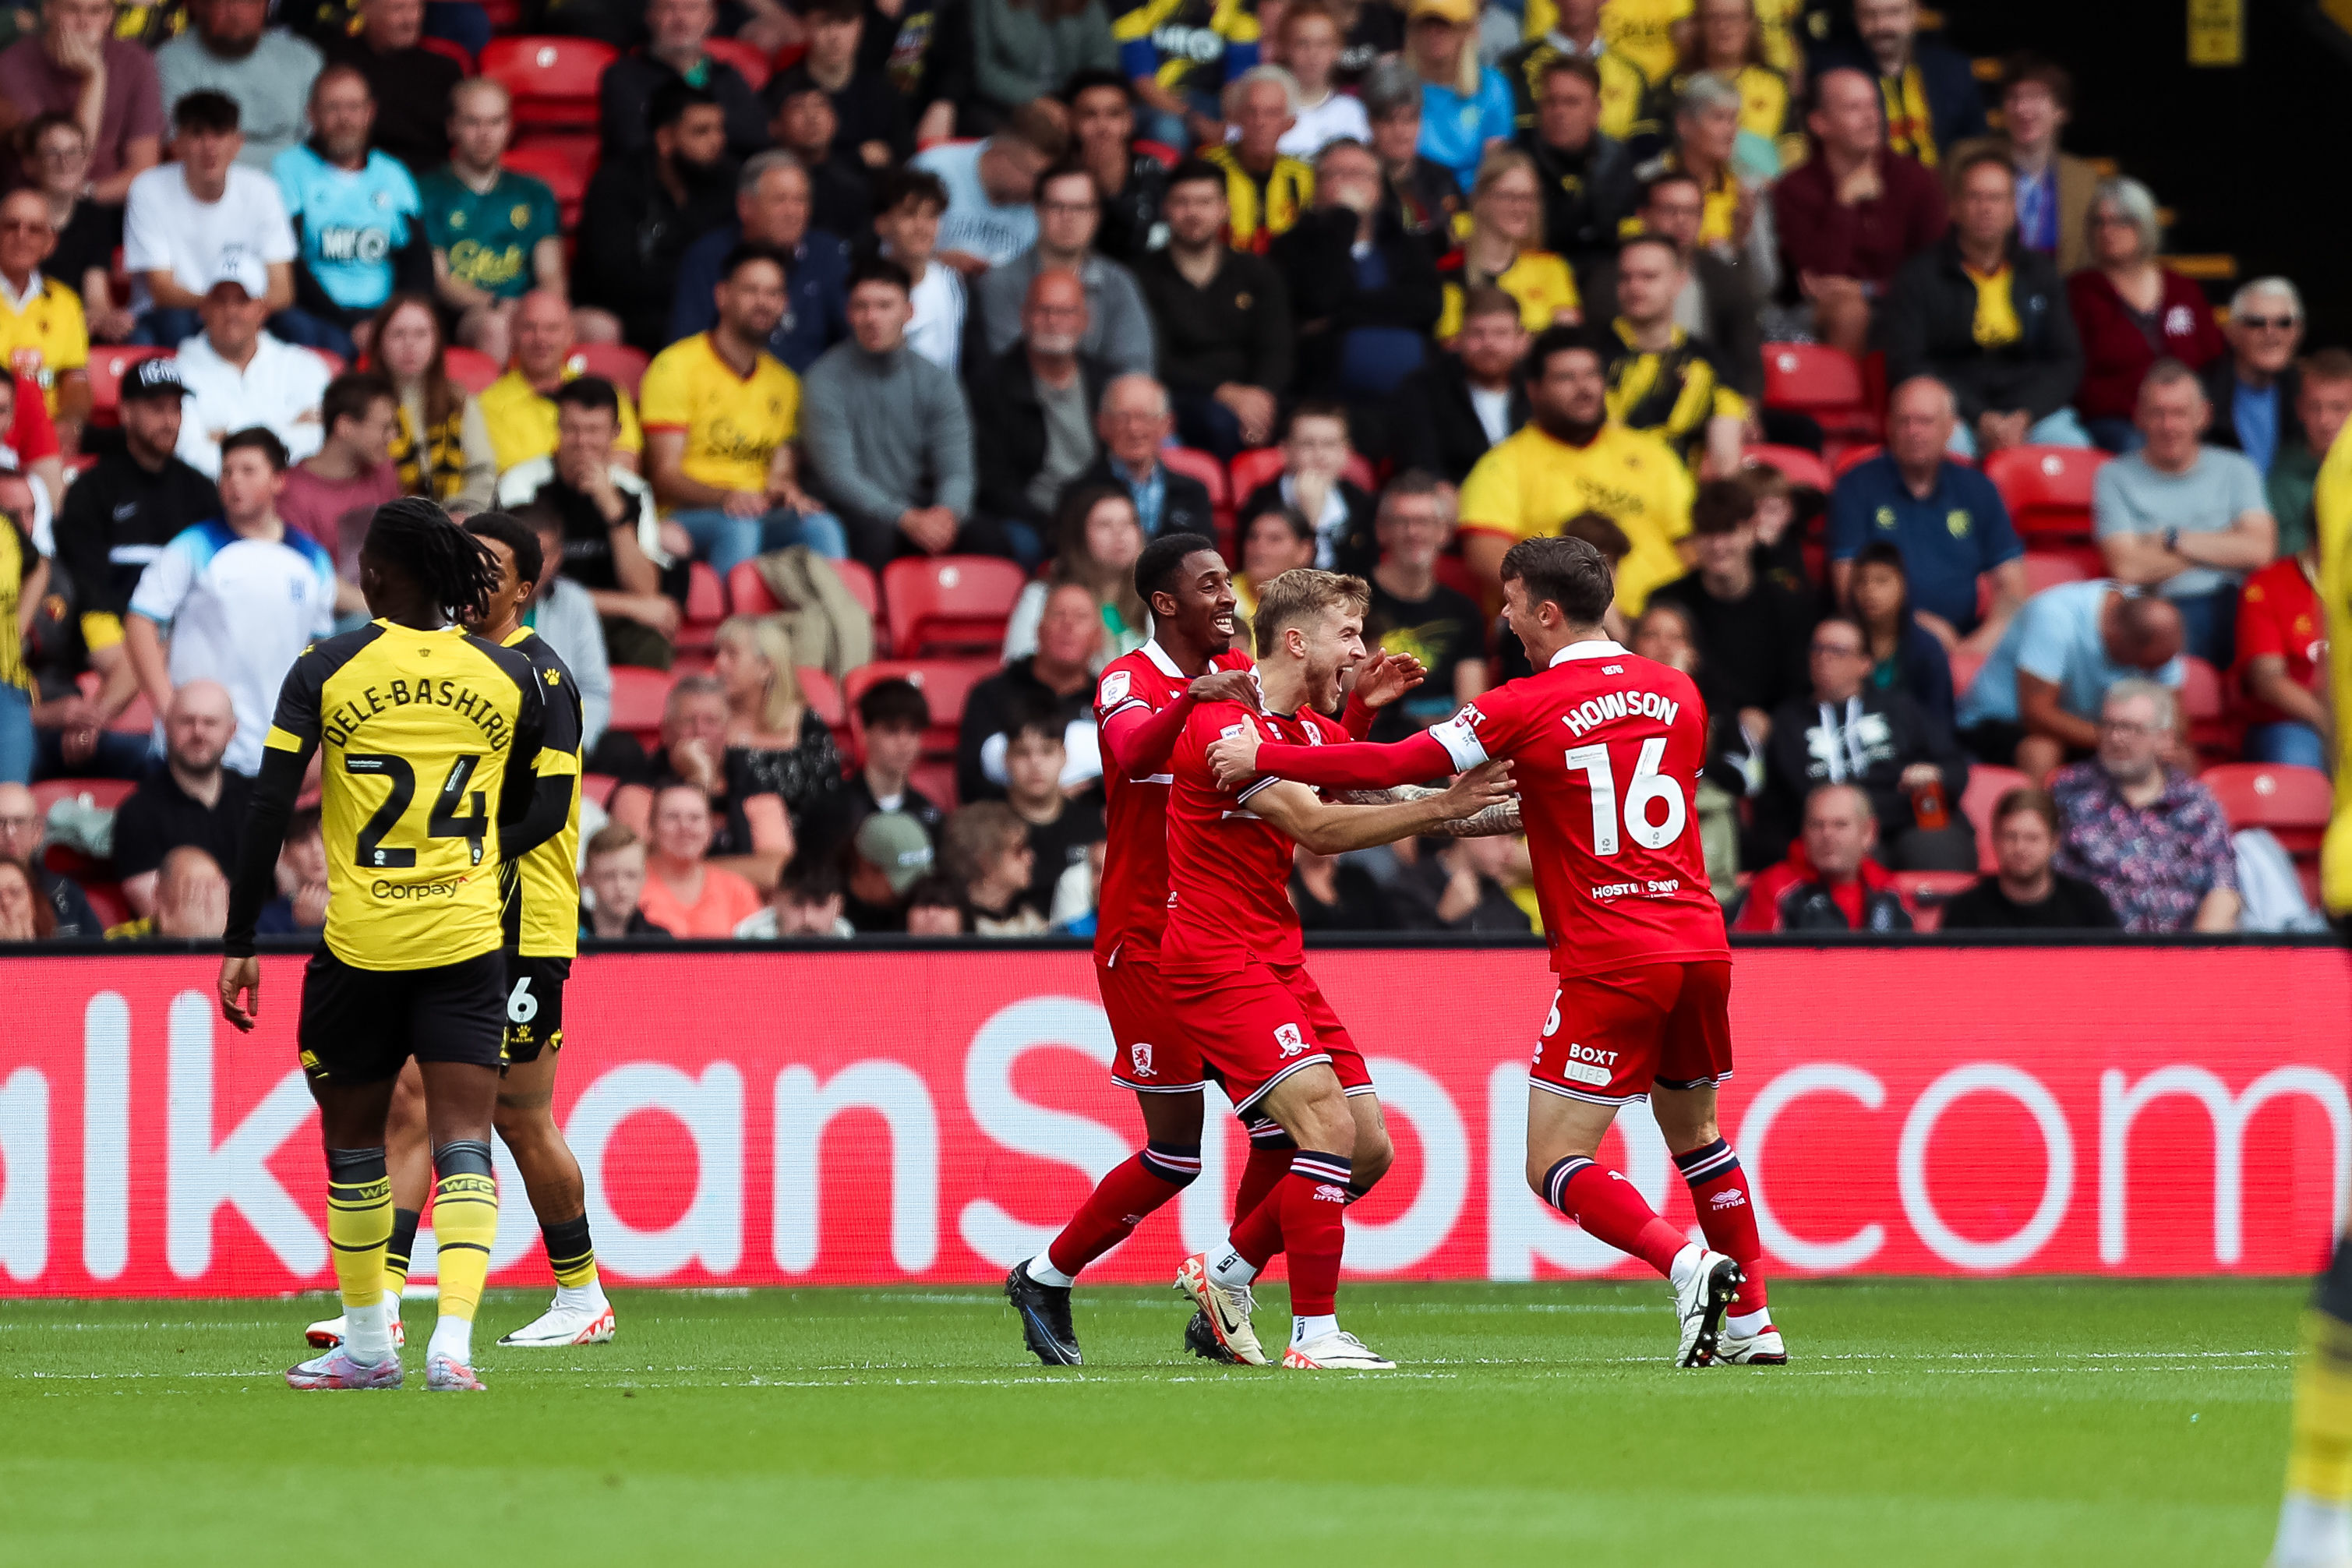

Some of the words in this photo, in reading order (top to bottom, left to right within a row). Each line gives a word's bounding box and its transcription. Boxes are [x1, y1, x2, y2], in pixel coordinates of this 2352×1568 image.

[1602, 665, 1624, 676] 1876
[323, 678, 511, 751] DELE-BASHIRU
[1561, 690, 1679, 737] HOWSON
[344, 754, 489, 868] 24
[1564, 737, 1686, 856] 16
[371, 878, 458, 902] Corpay
[507, 976, 539, 1023] 6
[1569, 1043, 1619, 1066] BOXT
[1569, 1063, 1605, 1083] LIFE
